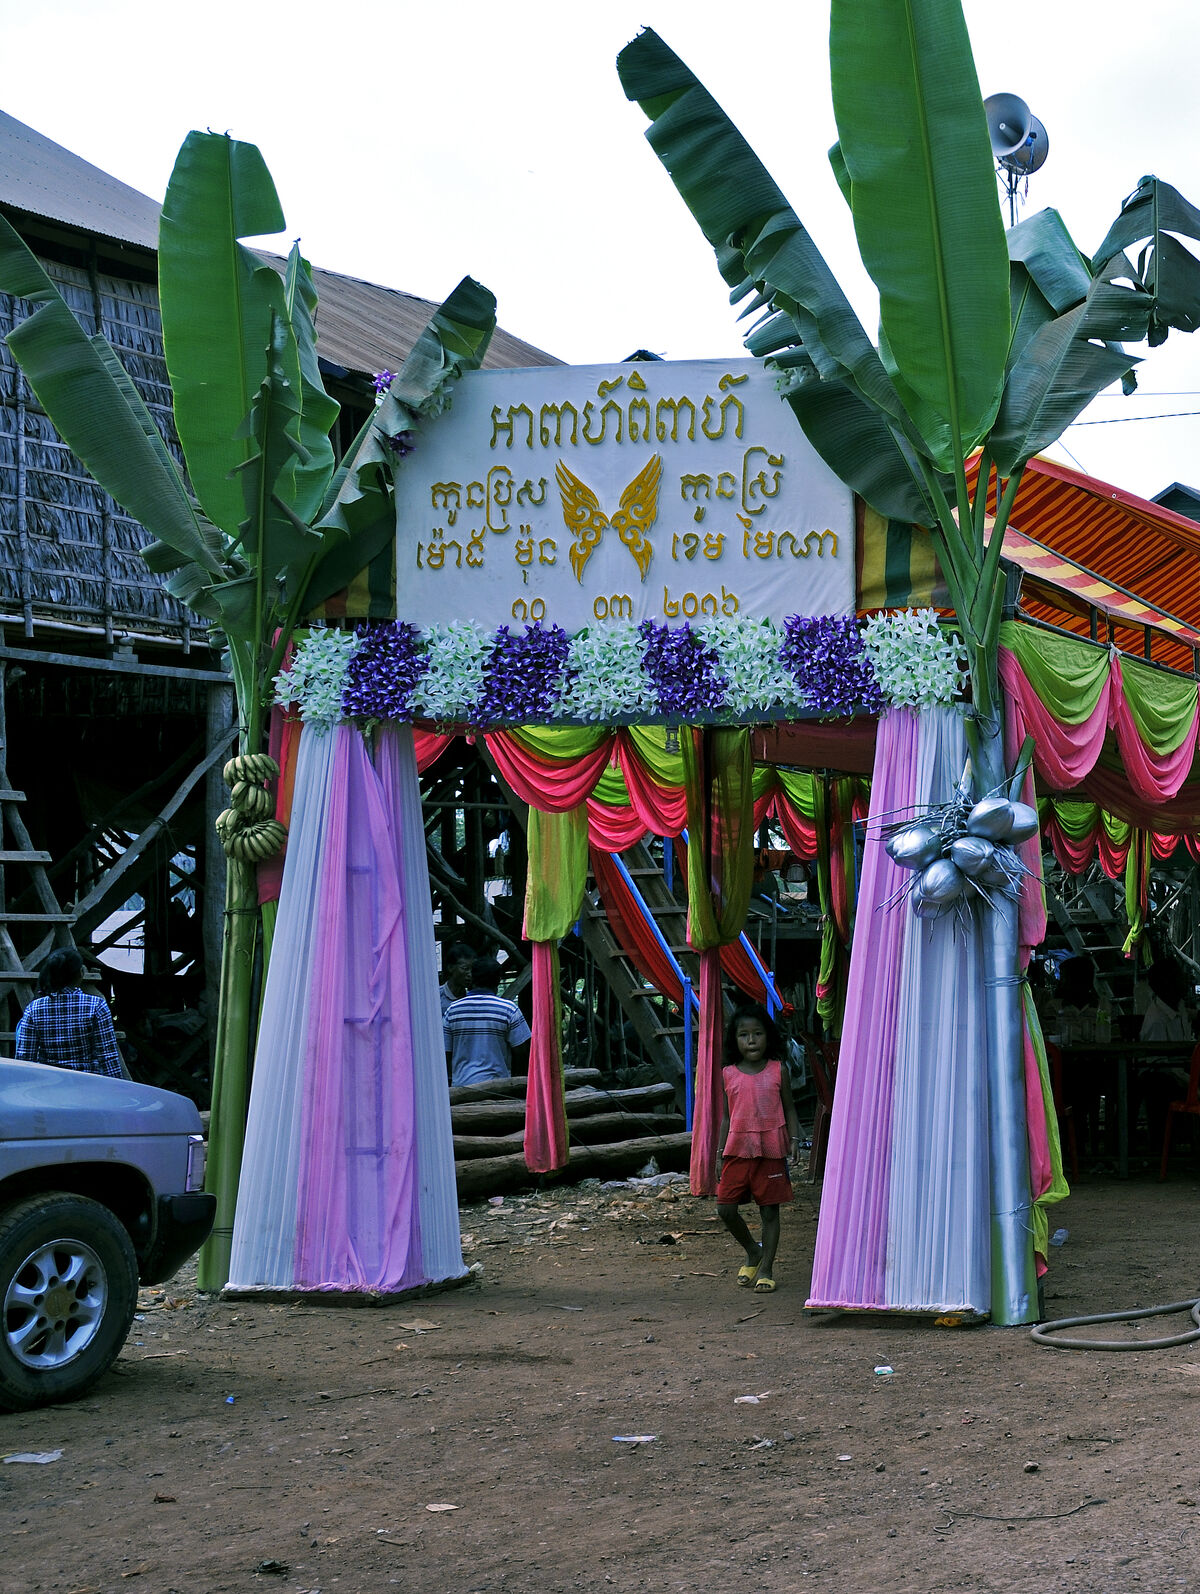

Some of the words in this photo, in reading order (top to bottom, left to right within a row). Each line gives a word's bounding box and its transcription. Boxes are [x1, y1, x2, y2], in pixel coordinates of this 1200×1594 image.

[490, 369, 749, 449] អាពាហ៍ពិពាហ៍
[431, 465, 549, 534] កូនប្រុស
[680, 446, 784, 522] កូនស្រី
[513, 523, 558, 585] ម៉ុន
[671, 532, 727, 561] ខេម
[736, 512, 839, 558] មៃណា
[511, 597, 547, 622] ១០
[593, 594, 633, 620] ០៣
[663, 585, 739, 618] ២០១៦
